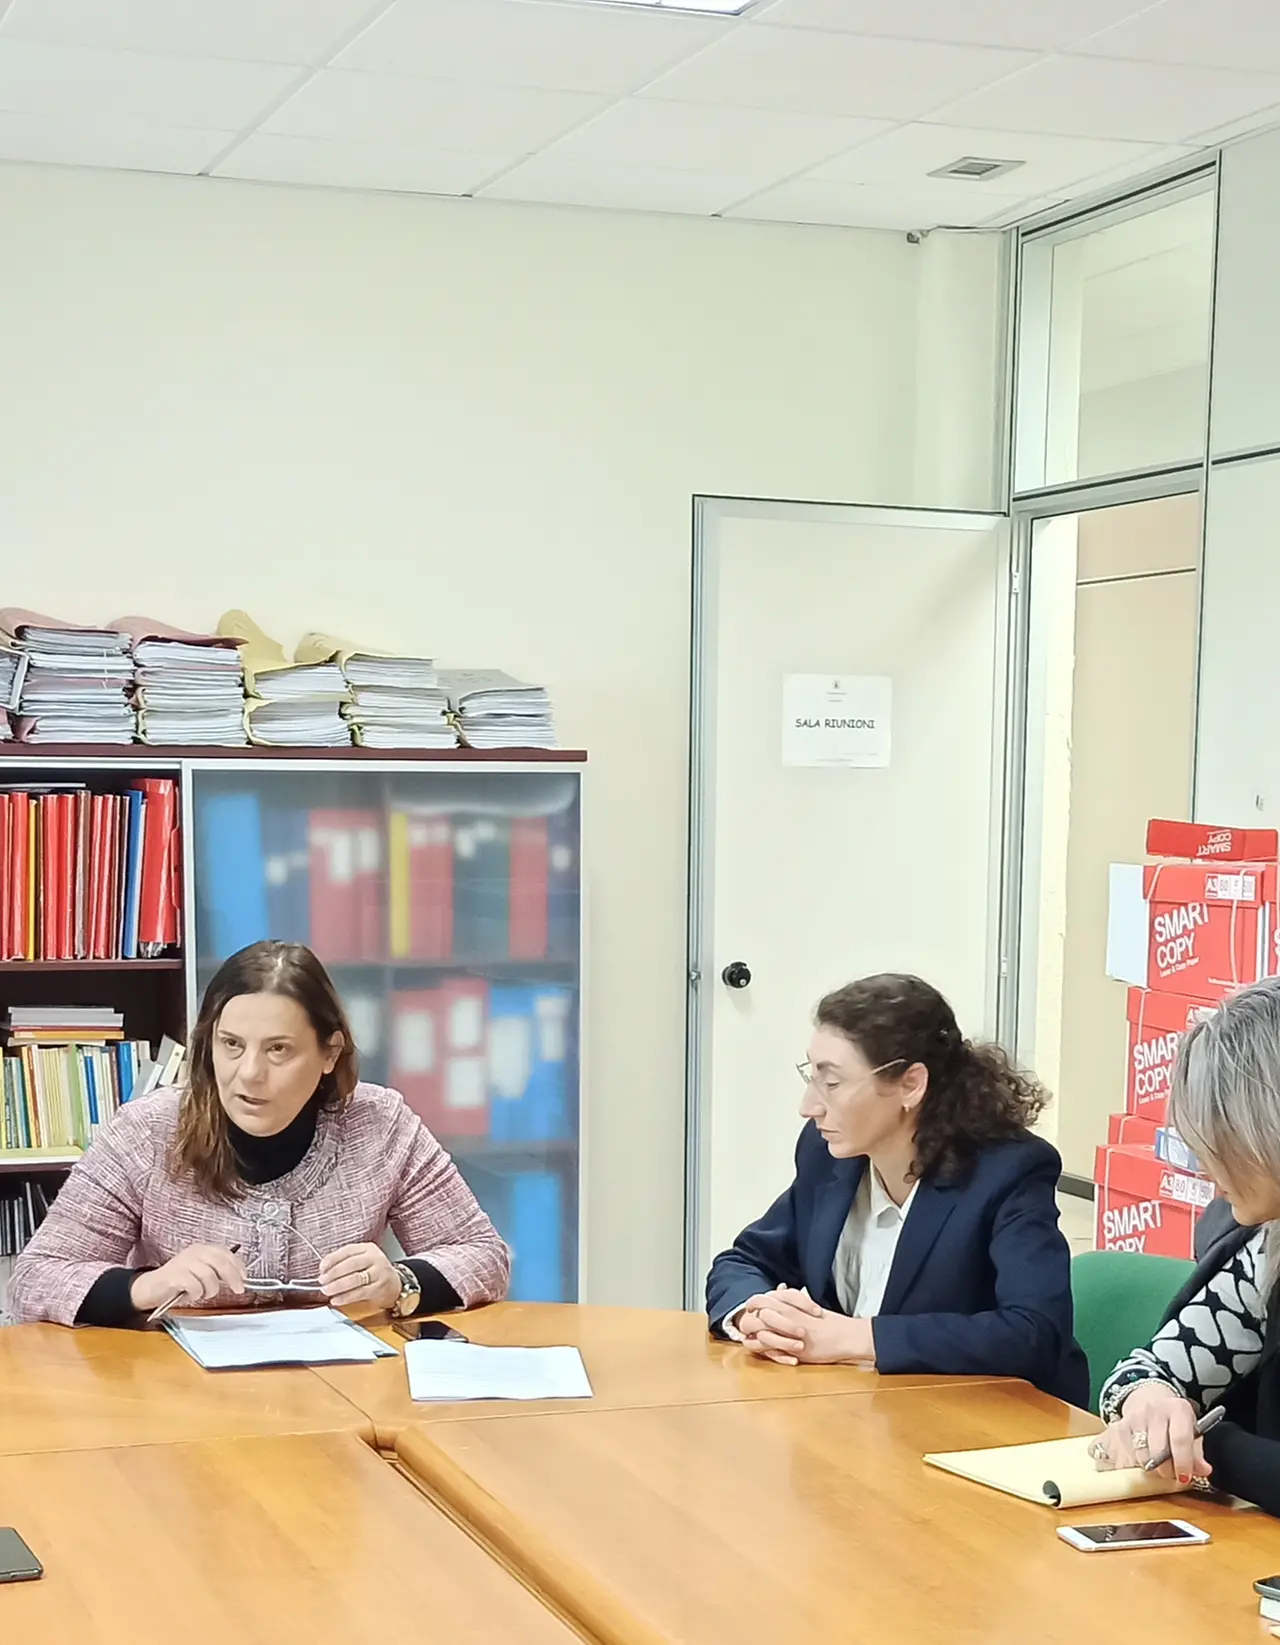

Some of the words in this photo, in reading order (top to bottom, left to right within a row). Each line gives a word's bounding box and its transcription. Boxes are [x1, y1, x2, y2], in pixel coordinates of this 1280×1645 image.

[795, 718, 821, 728] SALA
[824, 718, 875, 729] RIUNIONI
[1196, 841, 1232, 856] SMART
[1208, 832, 1232, 844] COPY
[1154, 902, 1209, 943] SMART
[1156, 932, 1196, 968] COPY
[1133, 1032, 1183, 1071] SMAR
[1135, 1062, 1173, 1095] COPY
[1160, 1174, 1173, 1191] A3
[1103, 1200, 1162, 1240] SMART
